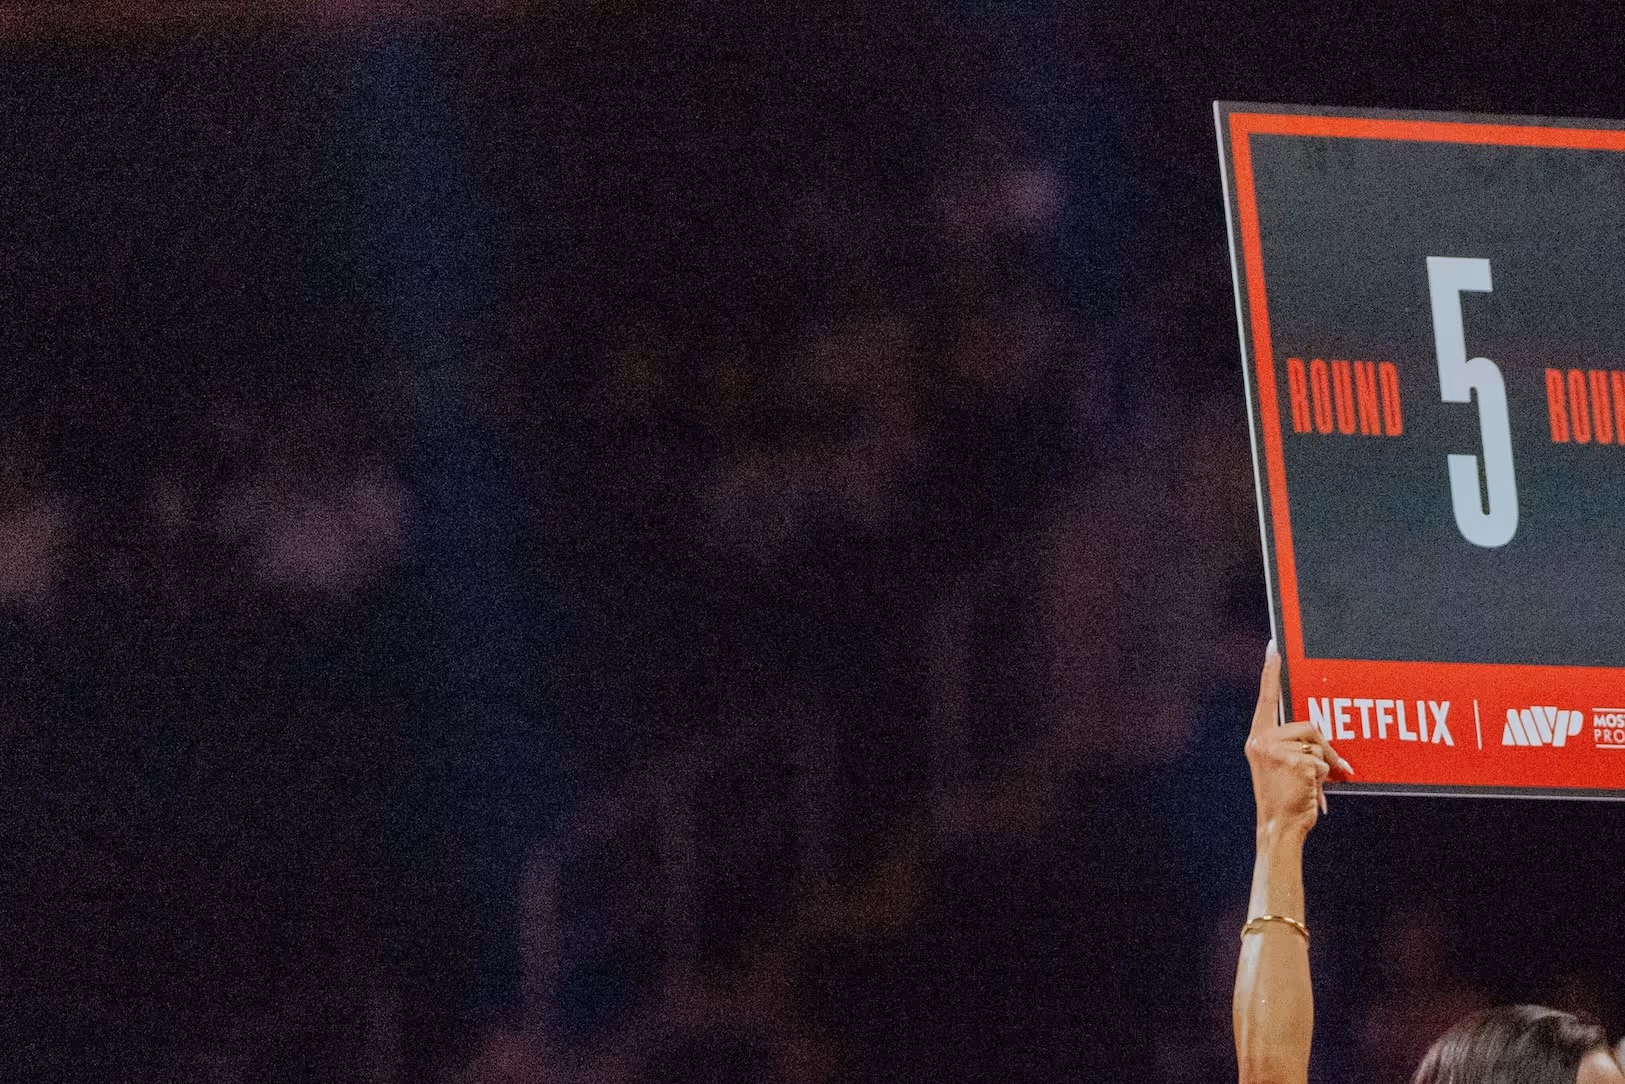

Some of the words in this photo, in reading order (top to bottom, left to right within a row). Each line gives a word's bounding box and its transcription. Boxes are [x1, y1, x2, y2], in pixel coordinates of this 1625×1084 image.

[1287, 358, 1403, 436] ROUND
[1426, 256, 1519, 547] 5
[1307, 697, 1455, 746] NETFLIX
